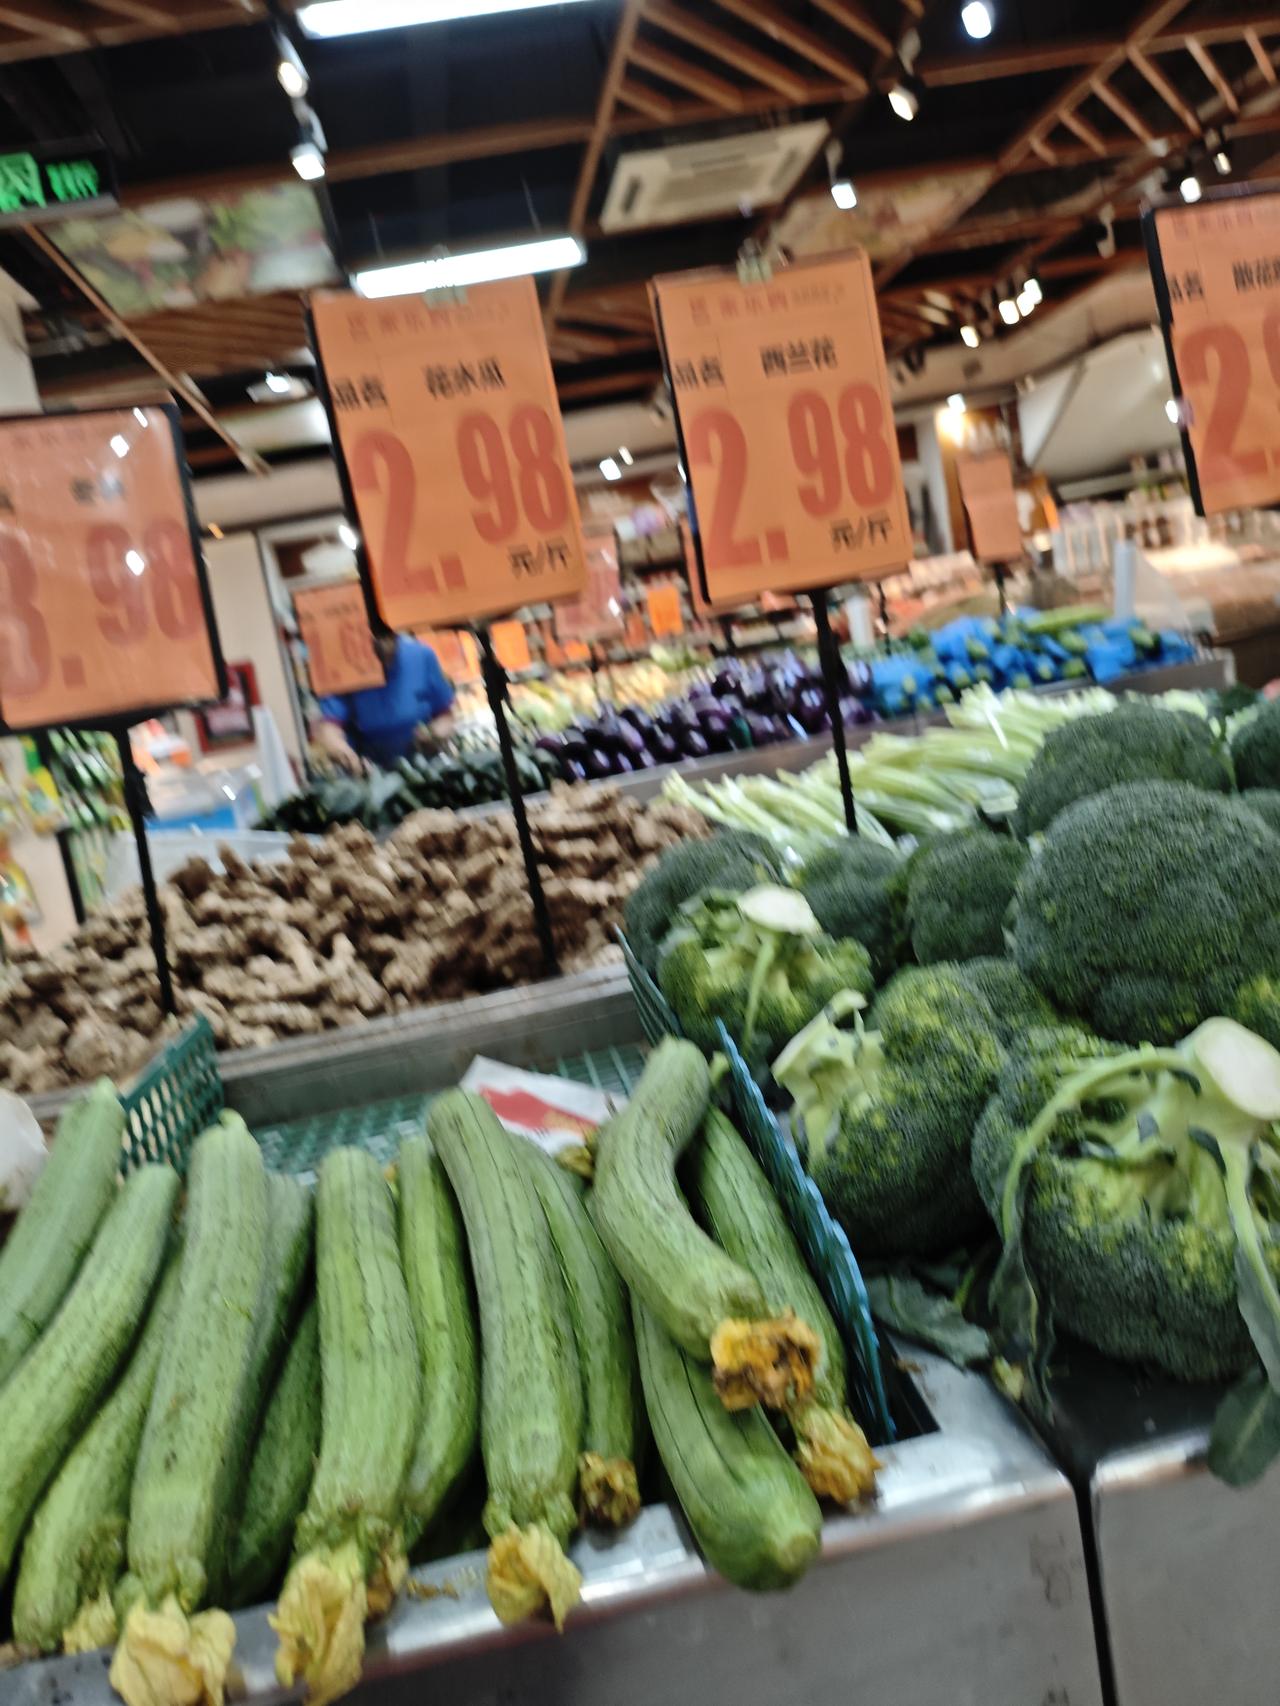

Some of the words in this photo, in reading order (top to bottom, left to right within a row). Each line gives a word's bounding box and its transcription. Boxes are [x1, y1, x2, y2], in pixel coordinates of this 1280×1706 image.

[760, 335, 838, 379] 西兰花
[689, 382, 894, 568] 2.98
[351, 404, 569, 597] 2.98
[829, 511, 892, 553] 元/斤
[508, 537, 570, 579] 元/斤
